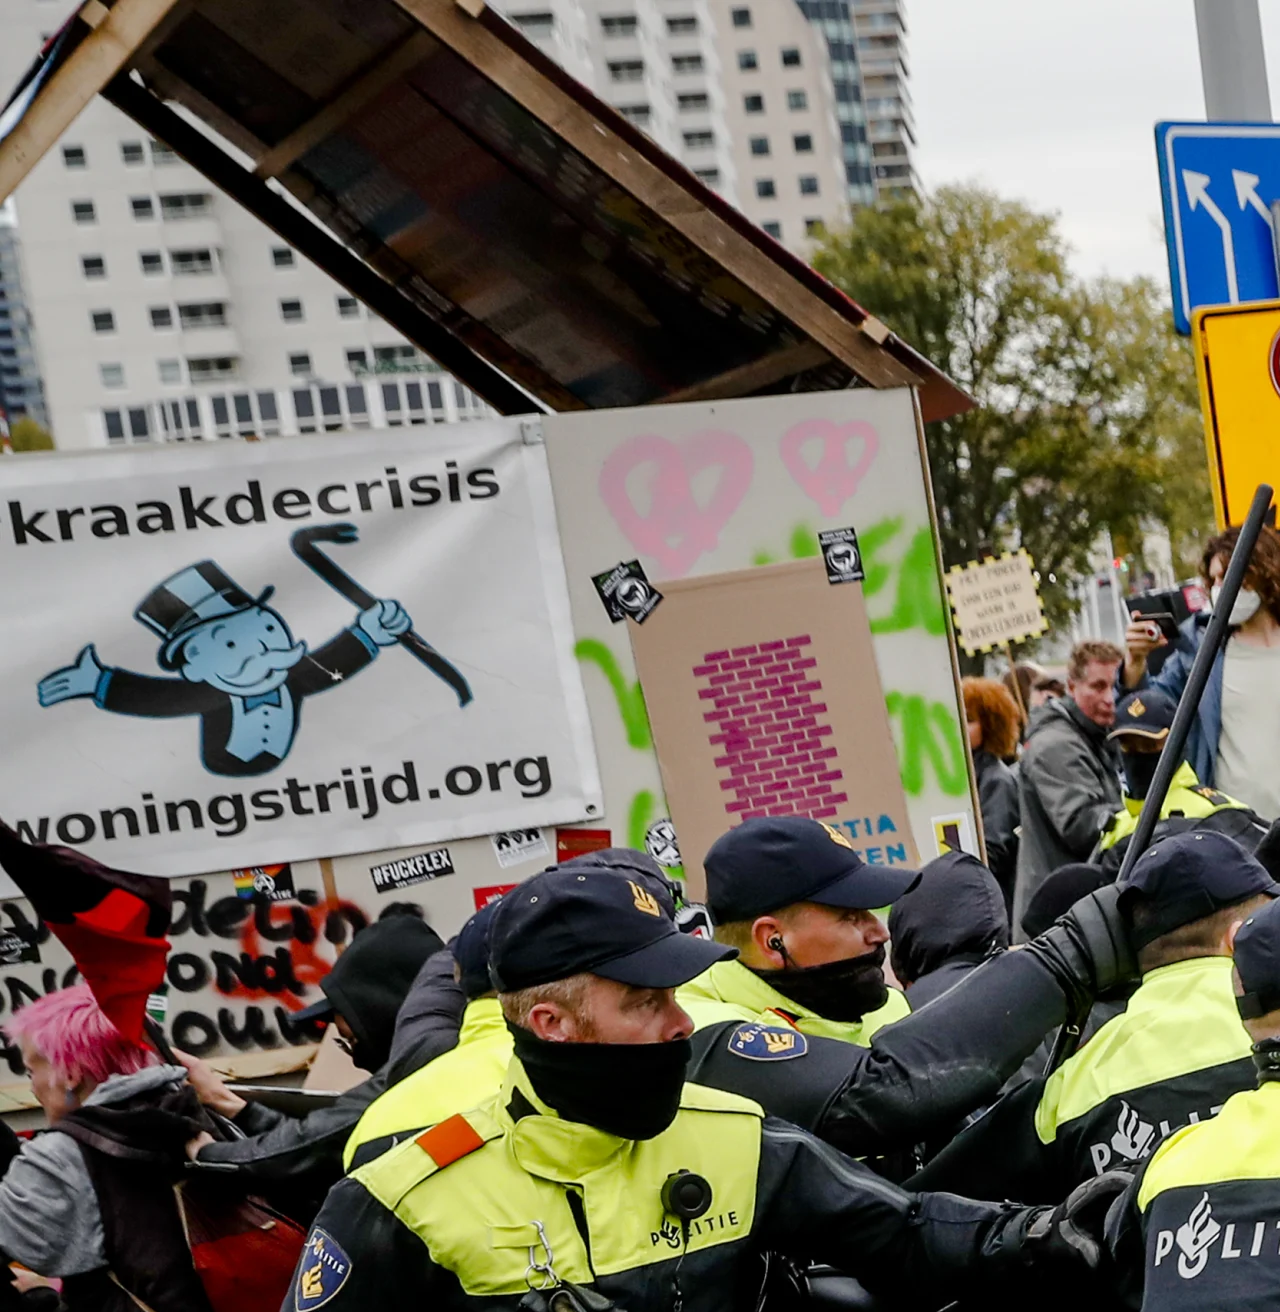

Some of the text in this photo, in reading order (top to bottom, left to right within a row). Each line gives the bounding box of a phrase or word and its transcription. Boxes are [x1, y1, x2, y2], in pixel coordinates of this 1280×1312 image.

[830, 814, 897, 839] TIA
[853, 843, 908, 865] EN
[372, 850, 451, 886] #FUCKFLEX
